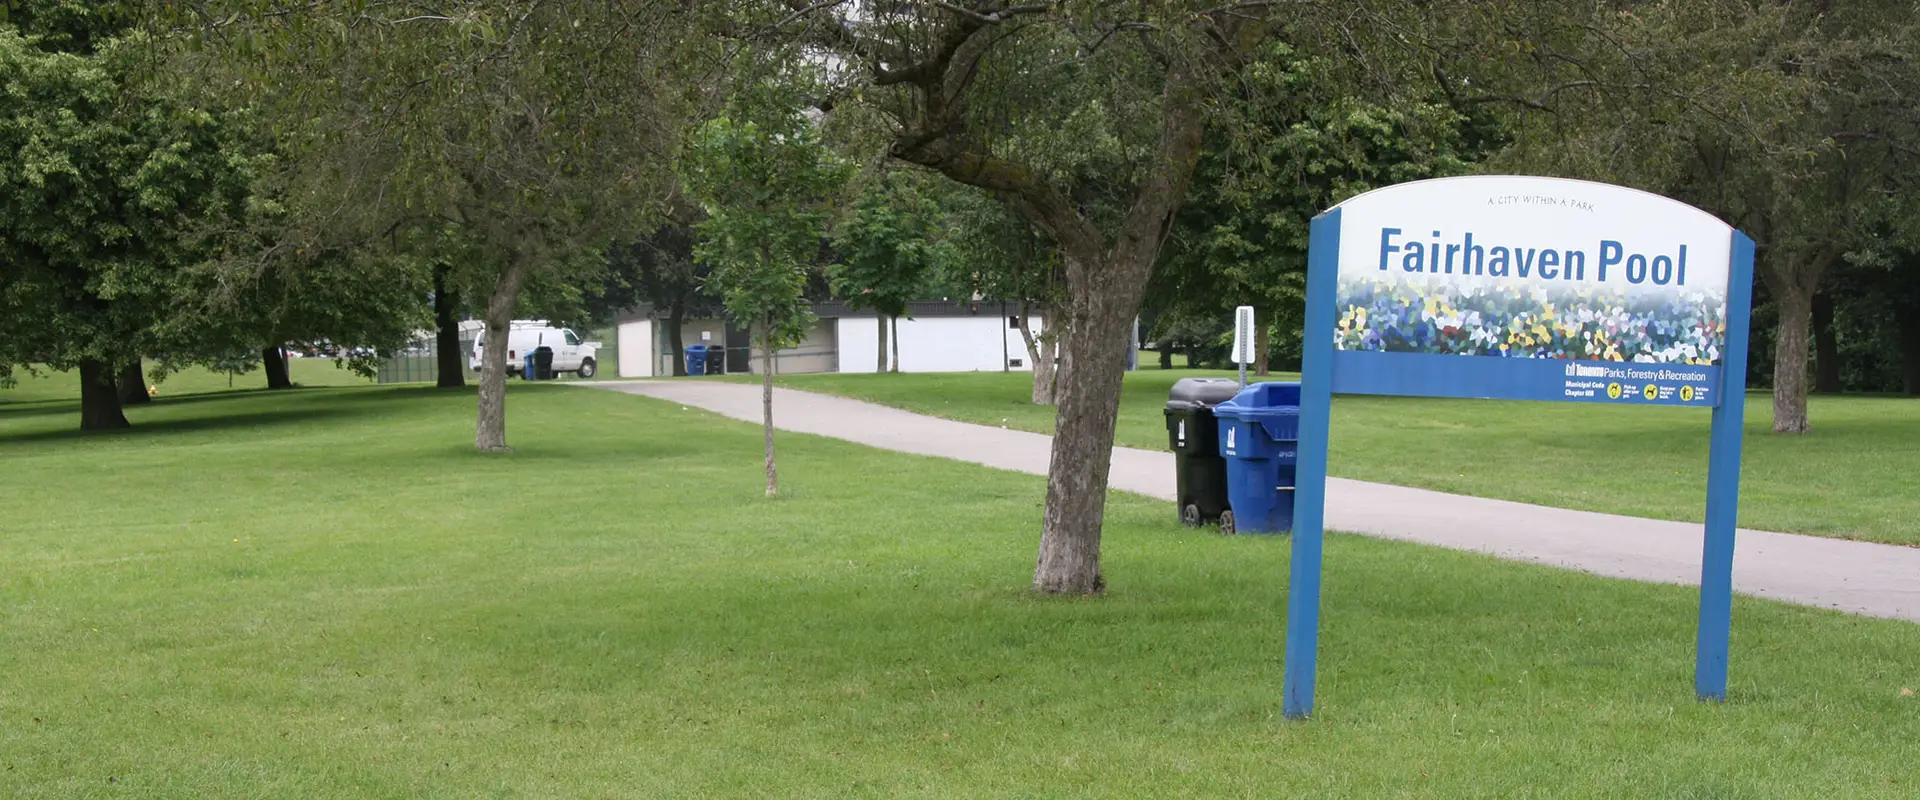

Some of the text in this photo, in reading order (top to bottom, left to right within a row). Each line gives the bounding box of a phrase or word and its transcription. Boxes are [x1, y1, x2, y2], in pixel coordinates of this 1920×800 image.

[1487, 195, 1594, 212] A CITY WITHIN A PARK
[1379, 227, 1687, 286] Fairhaven Pool
[1604, 368, 1627, 379] Parks,
[1627, 368, 1658, 382] Forestry
[1665, 370, 1706, 381] Recreation
[1565, 381, 1591, 389] Municipal
[1565, 389, 1584, 397] Chapter
